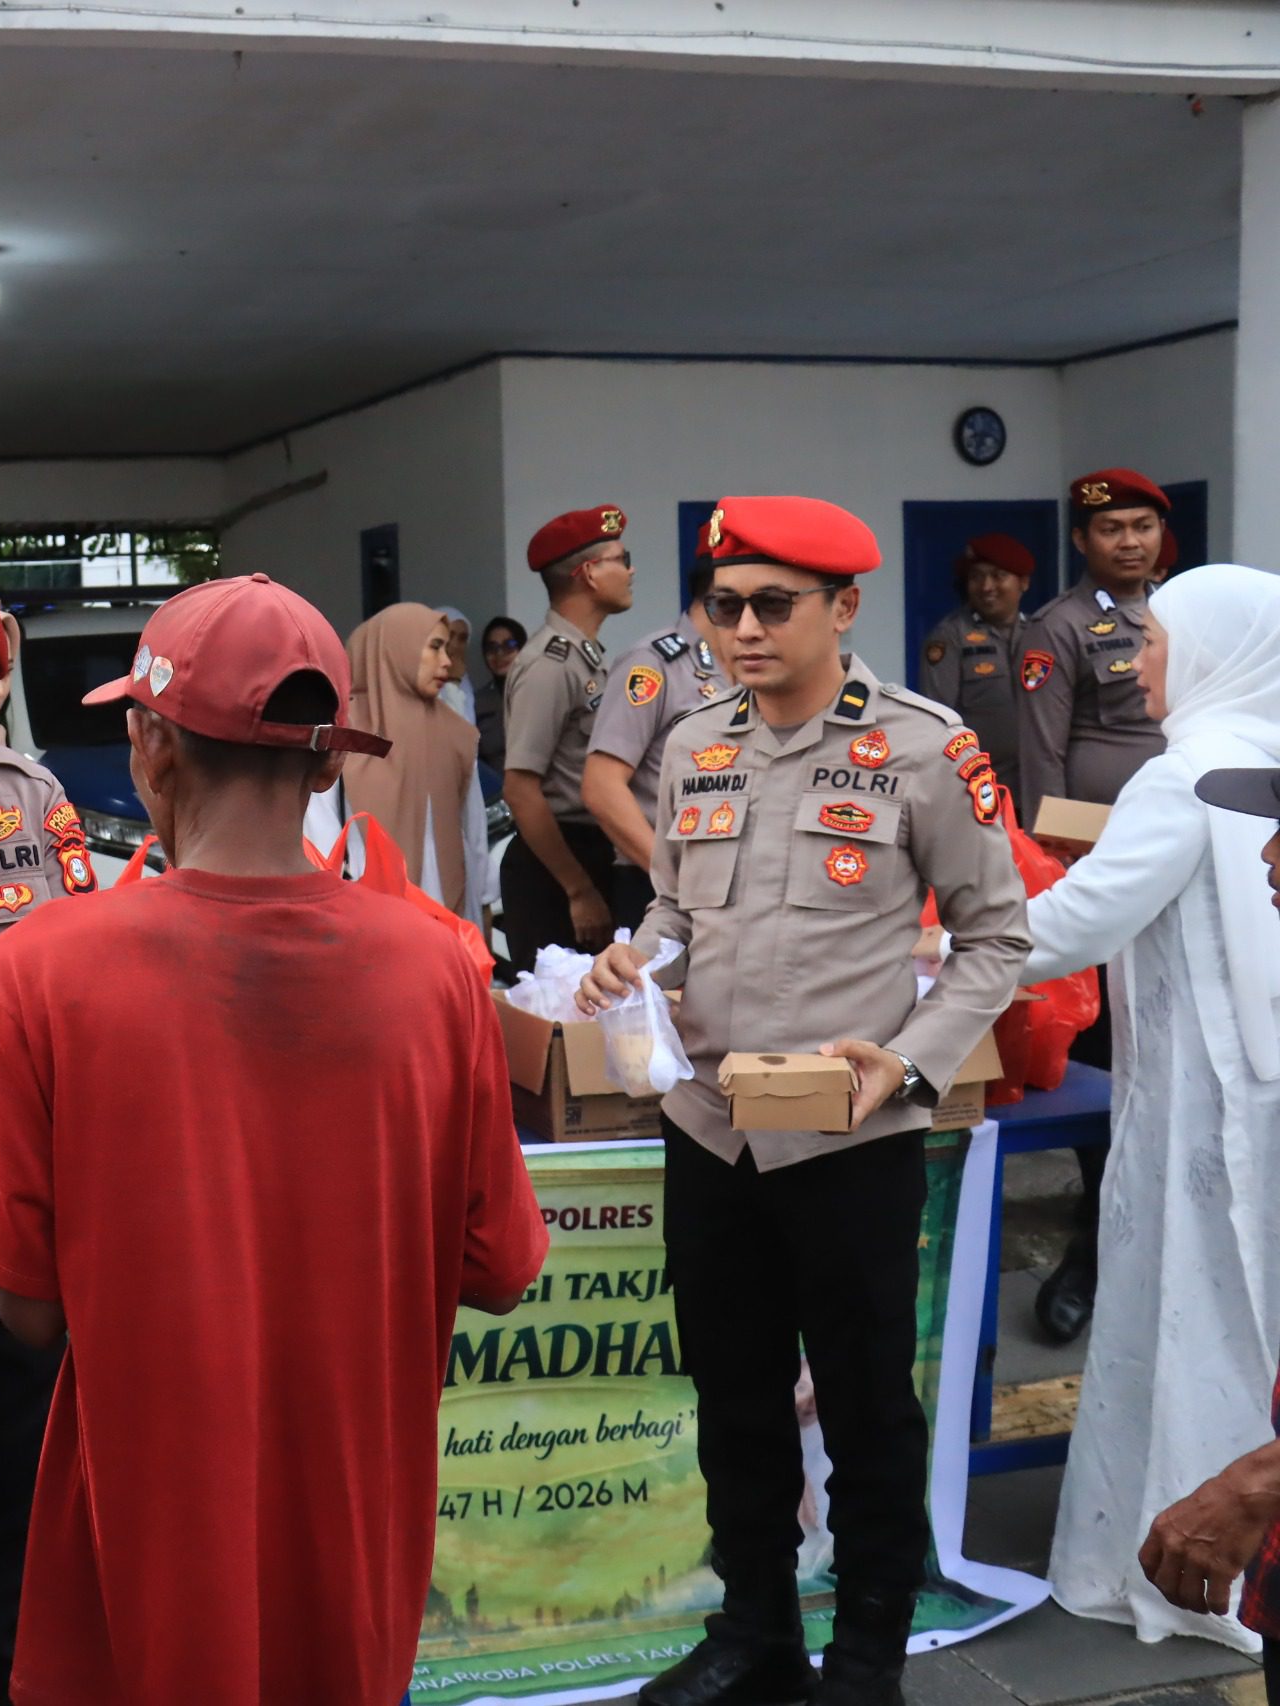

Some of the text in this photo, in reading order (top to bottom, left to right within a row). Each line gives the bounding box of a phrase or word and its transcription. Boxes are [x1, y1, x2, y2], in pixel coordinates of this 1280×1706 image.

[682, 775, 731, 796] HAMDAN
[812, 768, 899, 795] POLRI
[540, 1204, 654, 1231] POLRES
[443, 1320, 683, 1388] MADHA
[444, 1427, 493, 1457] hati
[500, 1421, 589, 1460] dengan
[438, 1492, 472, 1520] 47
[483, 1489, 502, 1516] H
[536, 1480, 613, 1512] 2026
[623, 1478, 648, 1503] M
[540, 1652, 631, 1674] POLRES
[634, 1641, 697, 1661] TAKA
